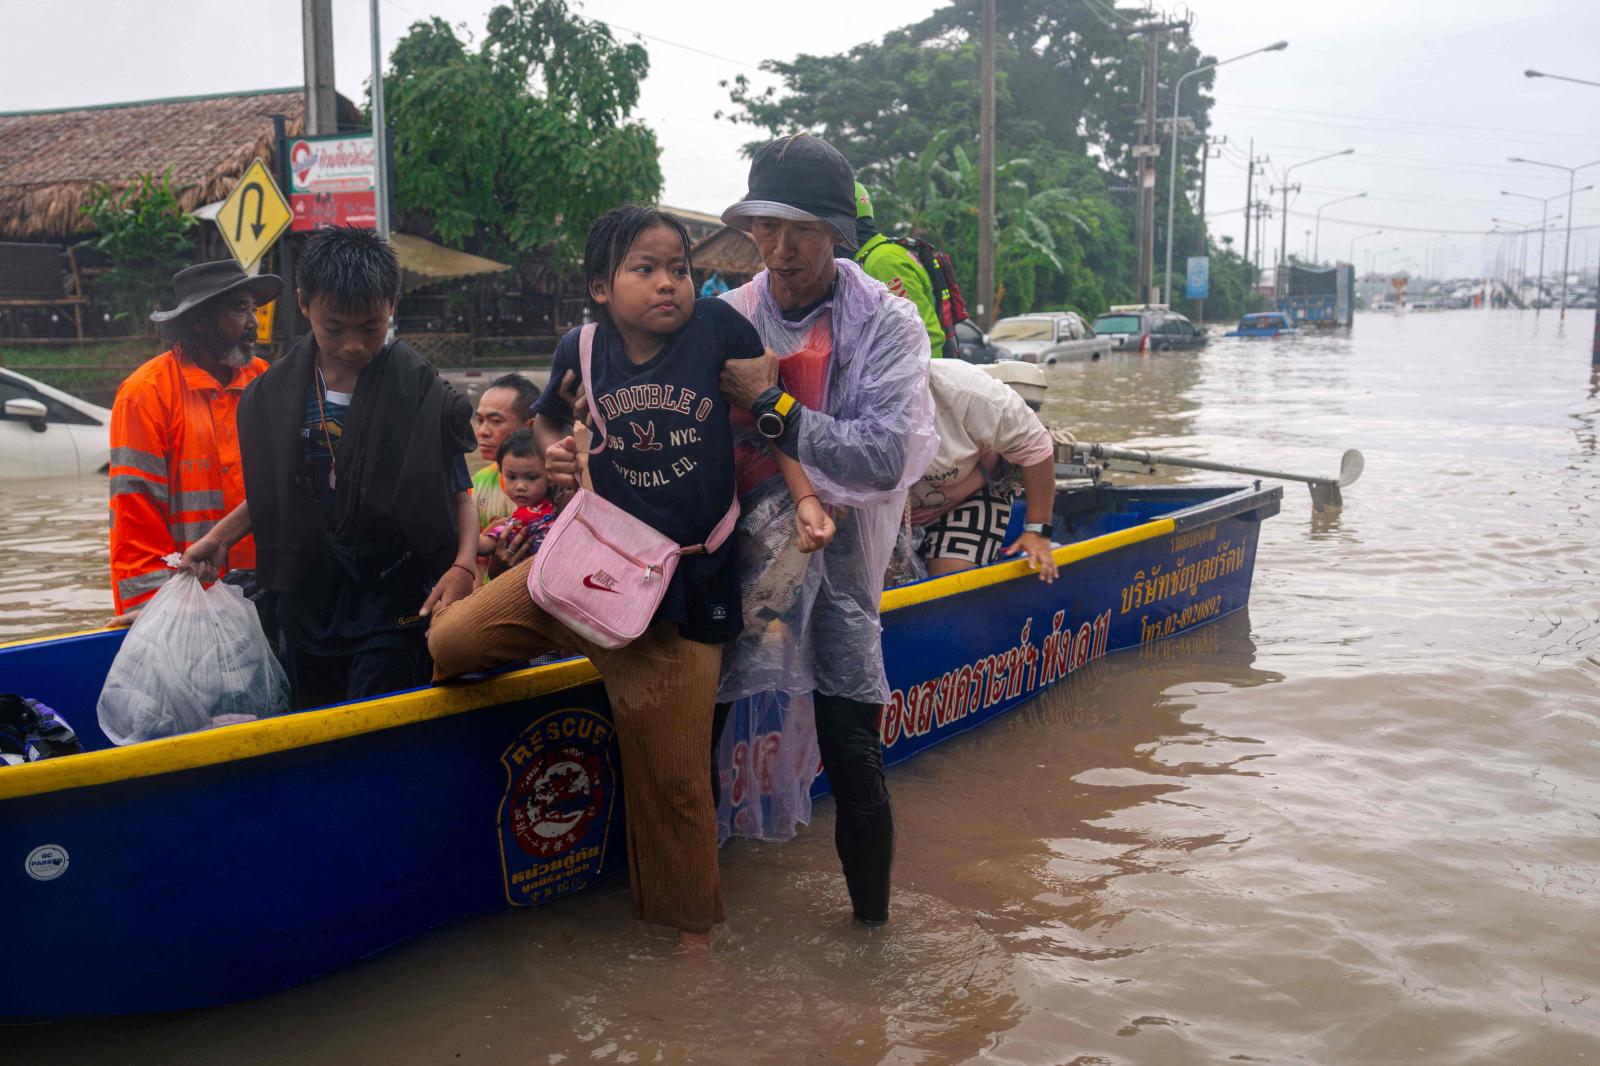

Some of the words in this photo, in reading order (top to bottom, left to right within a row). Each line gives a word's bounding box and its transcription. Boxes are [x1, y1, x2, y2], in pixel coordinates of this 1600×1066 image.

[598, 383, 696, 420] DOUBLE
[695, 397, 713, 422] O
[670, 427, 702, 447] NYC.
[612, 460, 671, 488] HYSICAL
[672, 456, 698, 478] ED.
